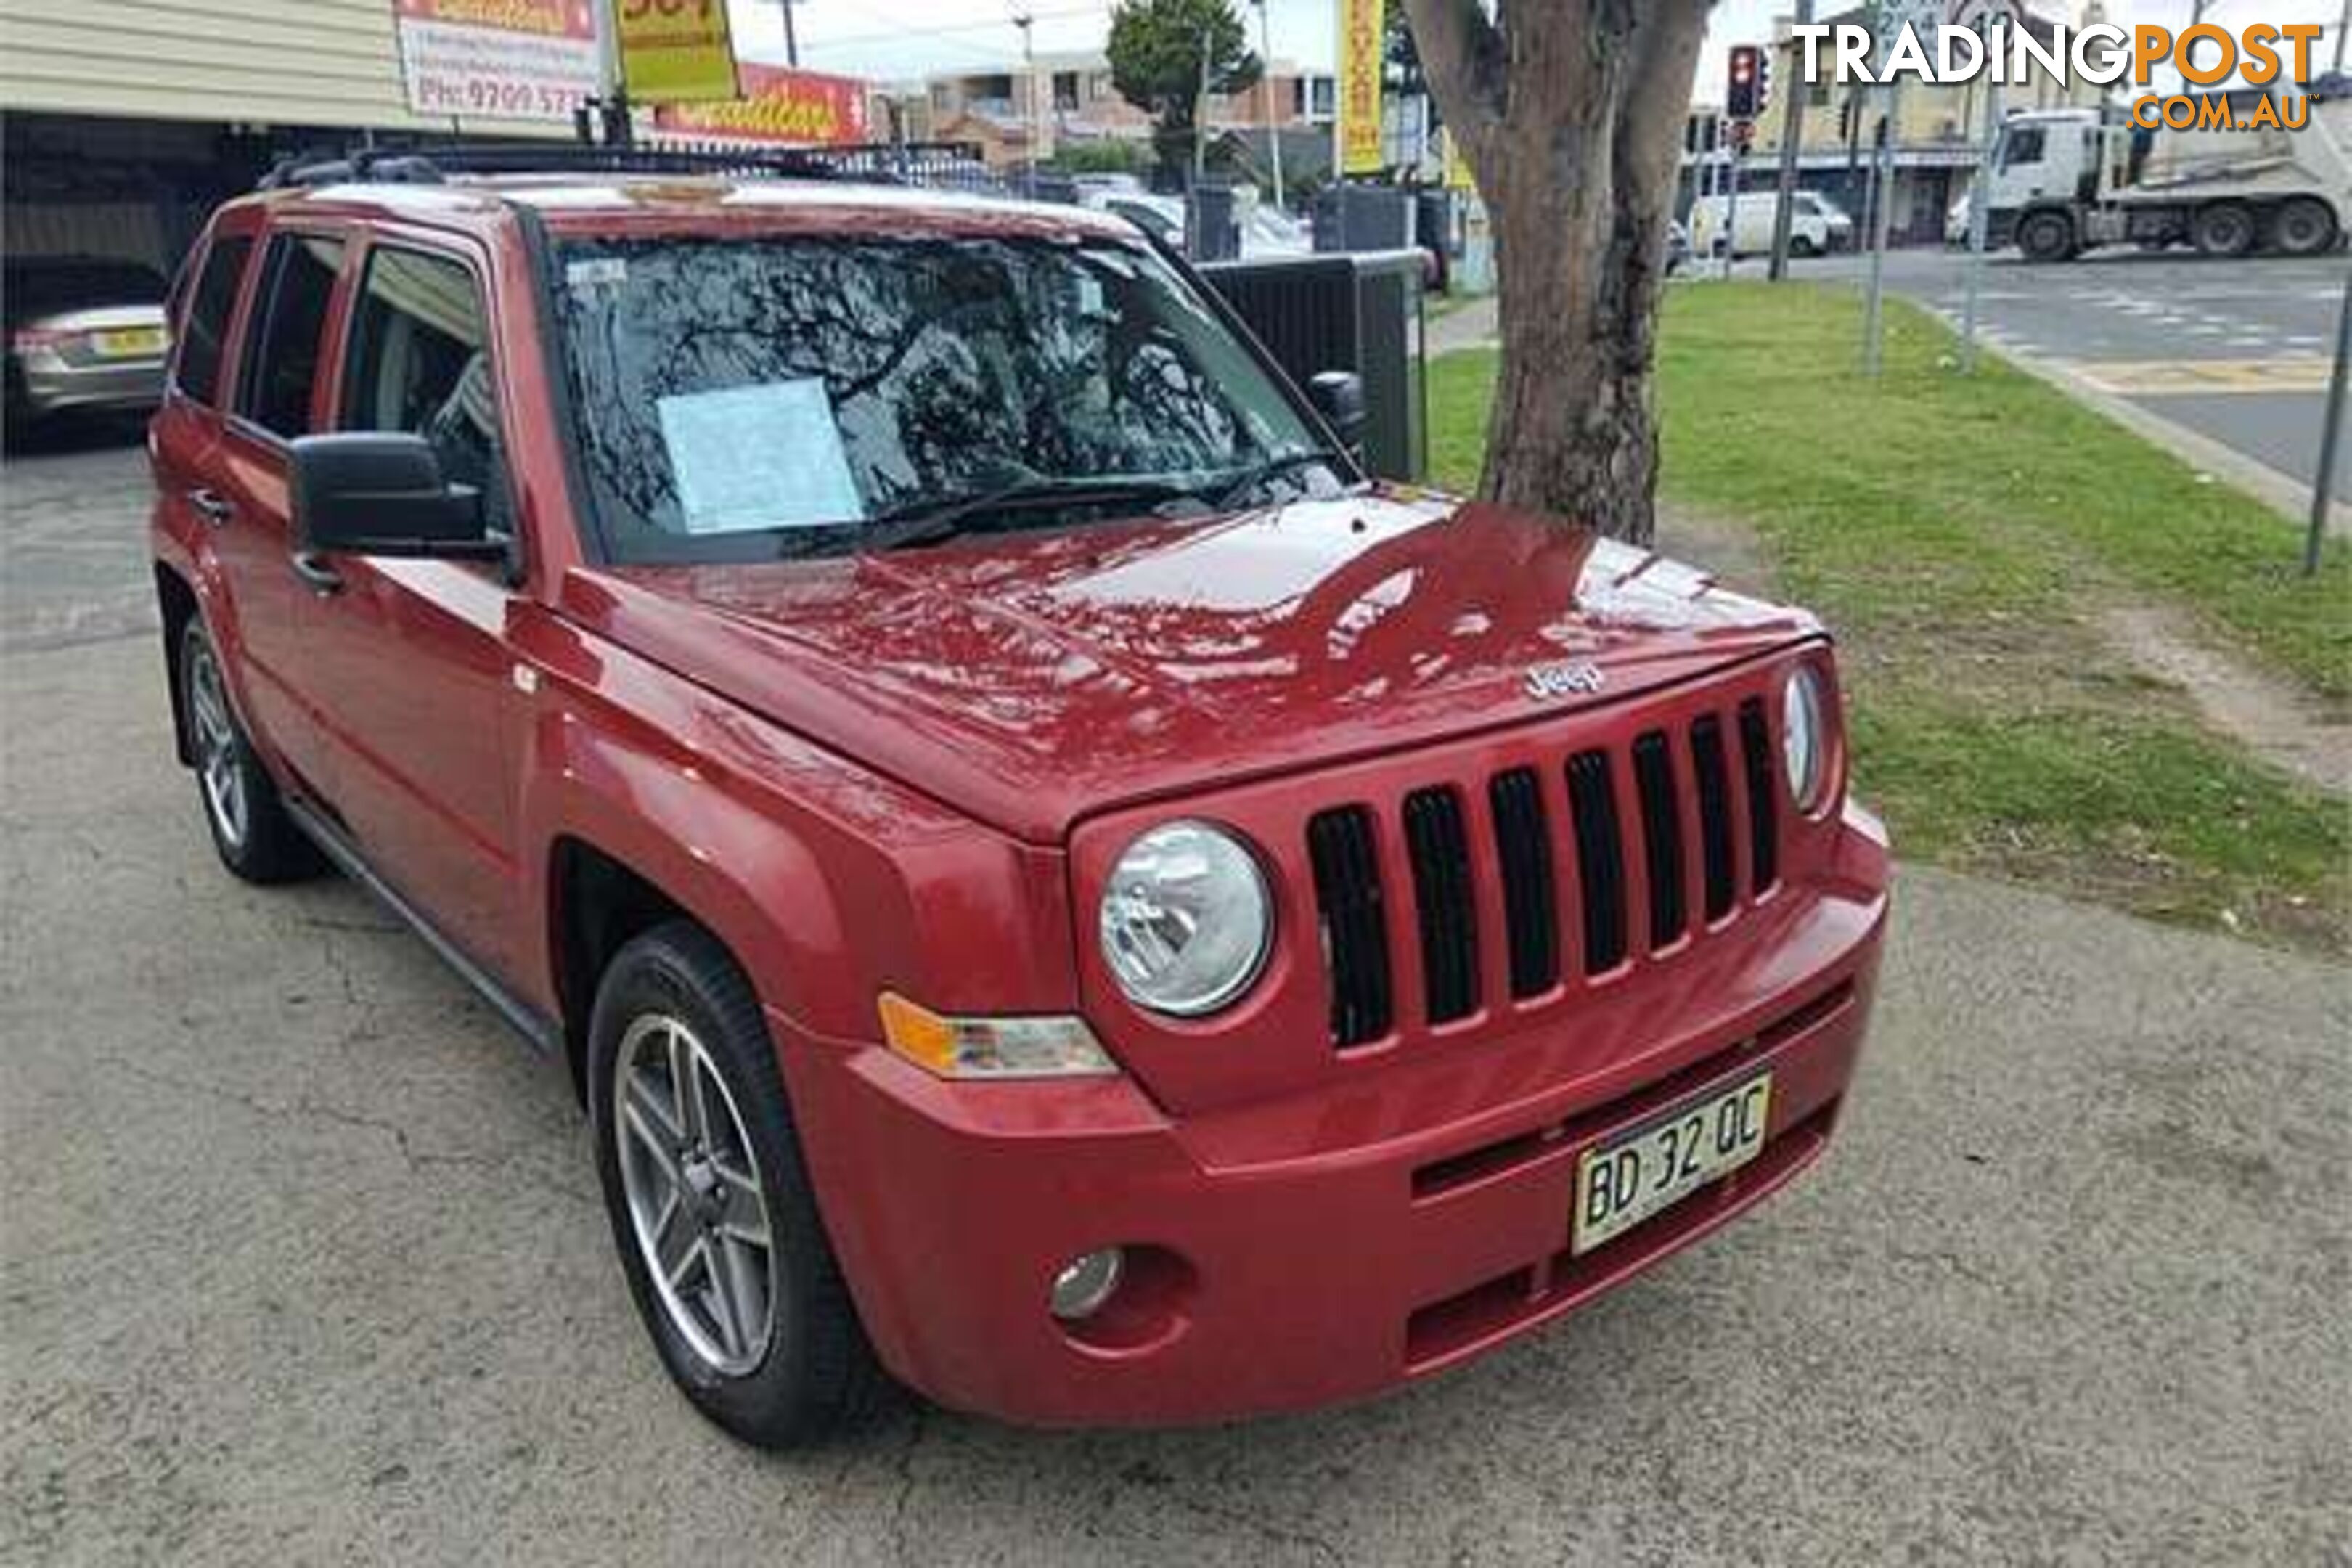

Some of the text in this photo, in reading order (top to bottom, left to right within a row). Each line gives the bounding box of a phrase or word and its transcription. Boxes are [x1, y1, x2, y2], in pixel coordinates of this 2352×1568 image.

[1525, 661, 1604, 698] Jeep
[1585, 1148, 1639, 1227] BD
[1655, 1116, 1702, 1191] 32
